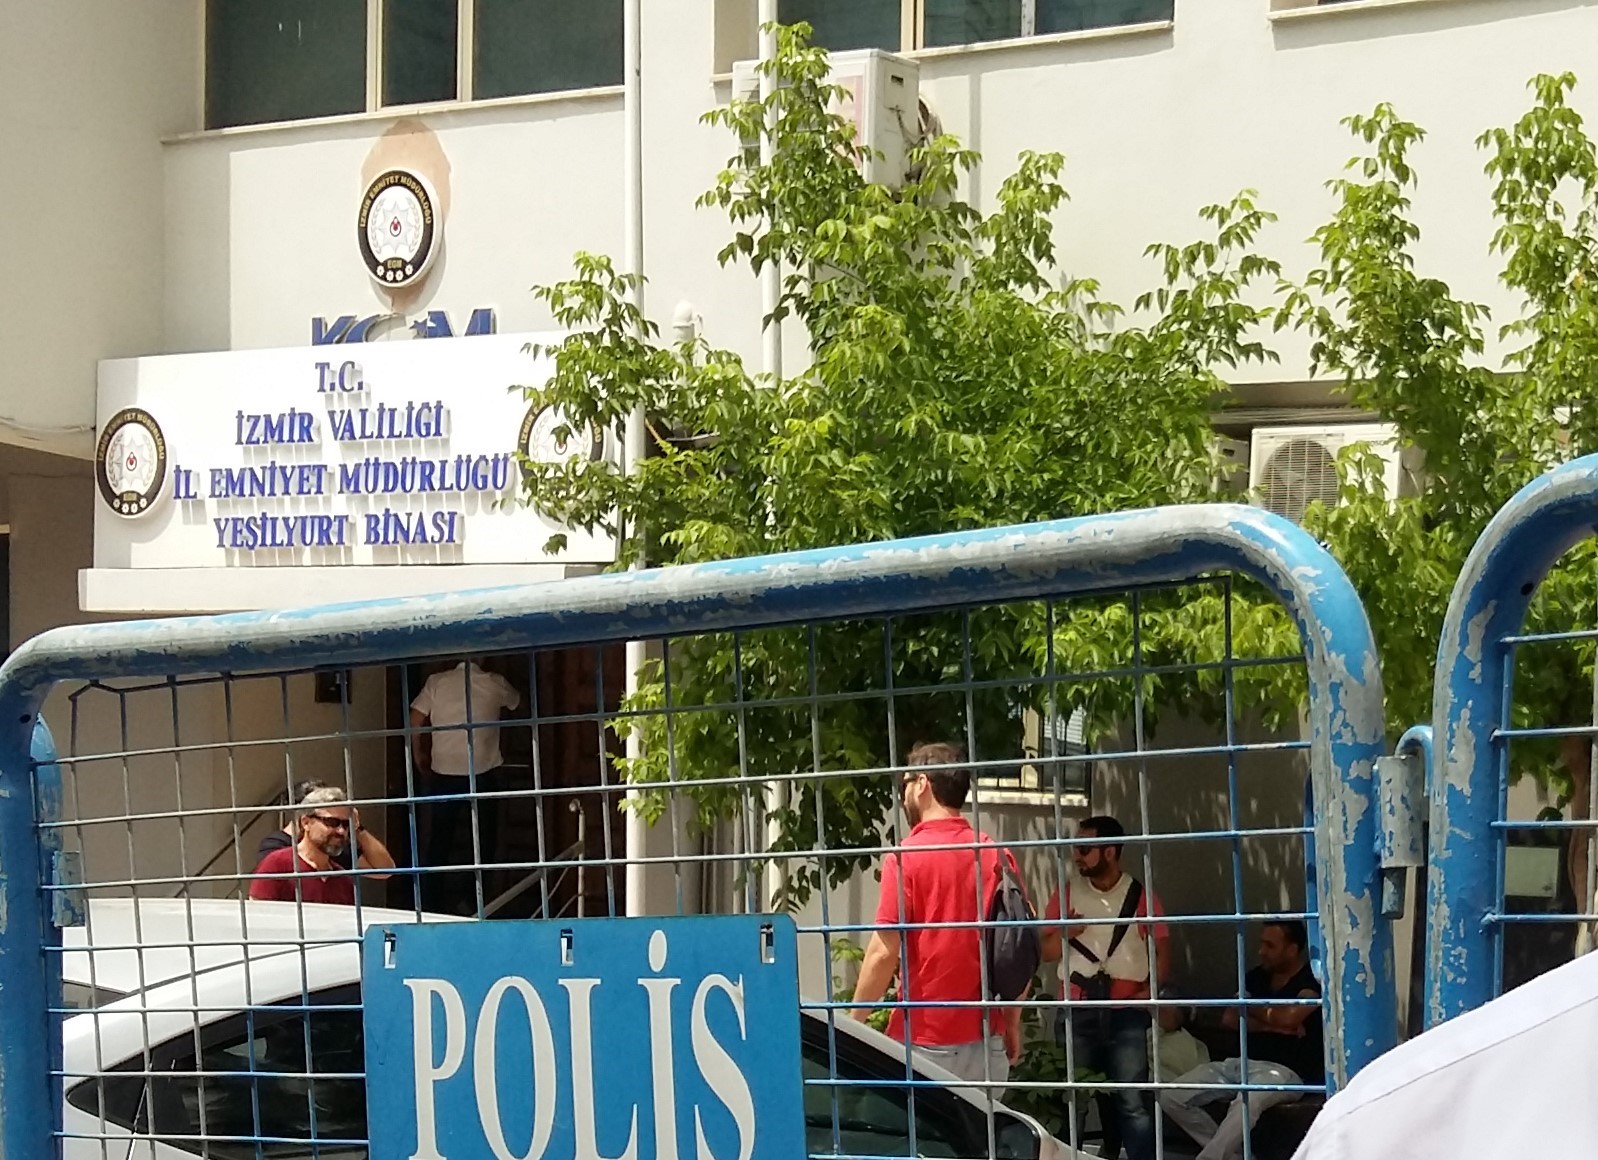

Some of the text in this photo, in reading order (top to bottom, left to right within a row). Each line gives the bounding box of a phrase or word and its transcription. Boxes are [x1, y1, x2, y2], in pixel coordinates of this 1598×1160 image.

[315, 360, 364, 392] T.C.
[235, 400, 444, 445] İZMİR VALİLİĞİ
[173, 452, 510, 500] İL EMNİYET MÜDÜRLÜĞÜ
[213, 507, 458, 551] YEŞİLYURT BİNASI
